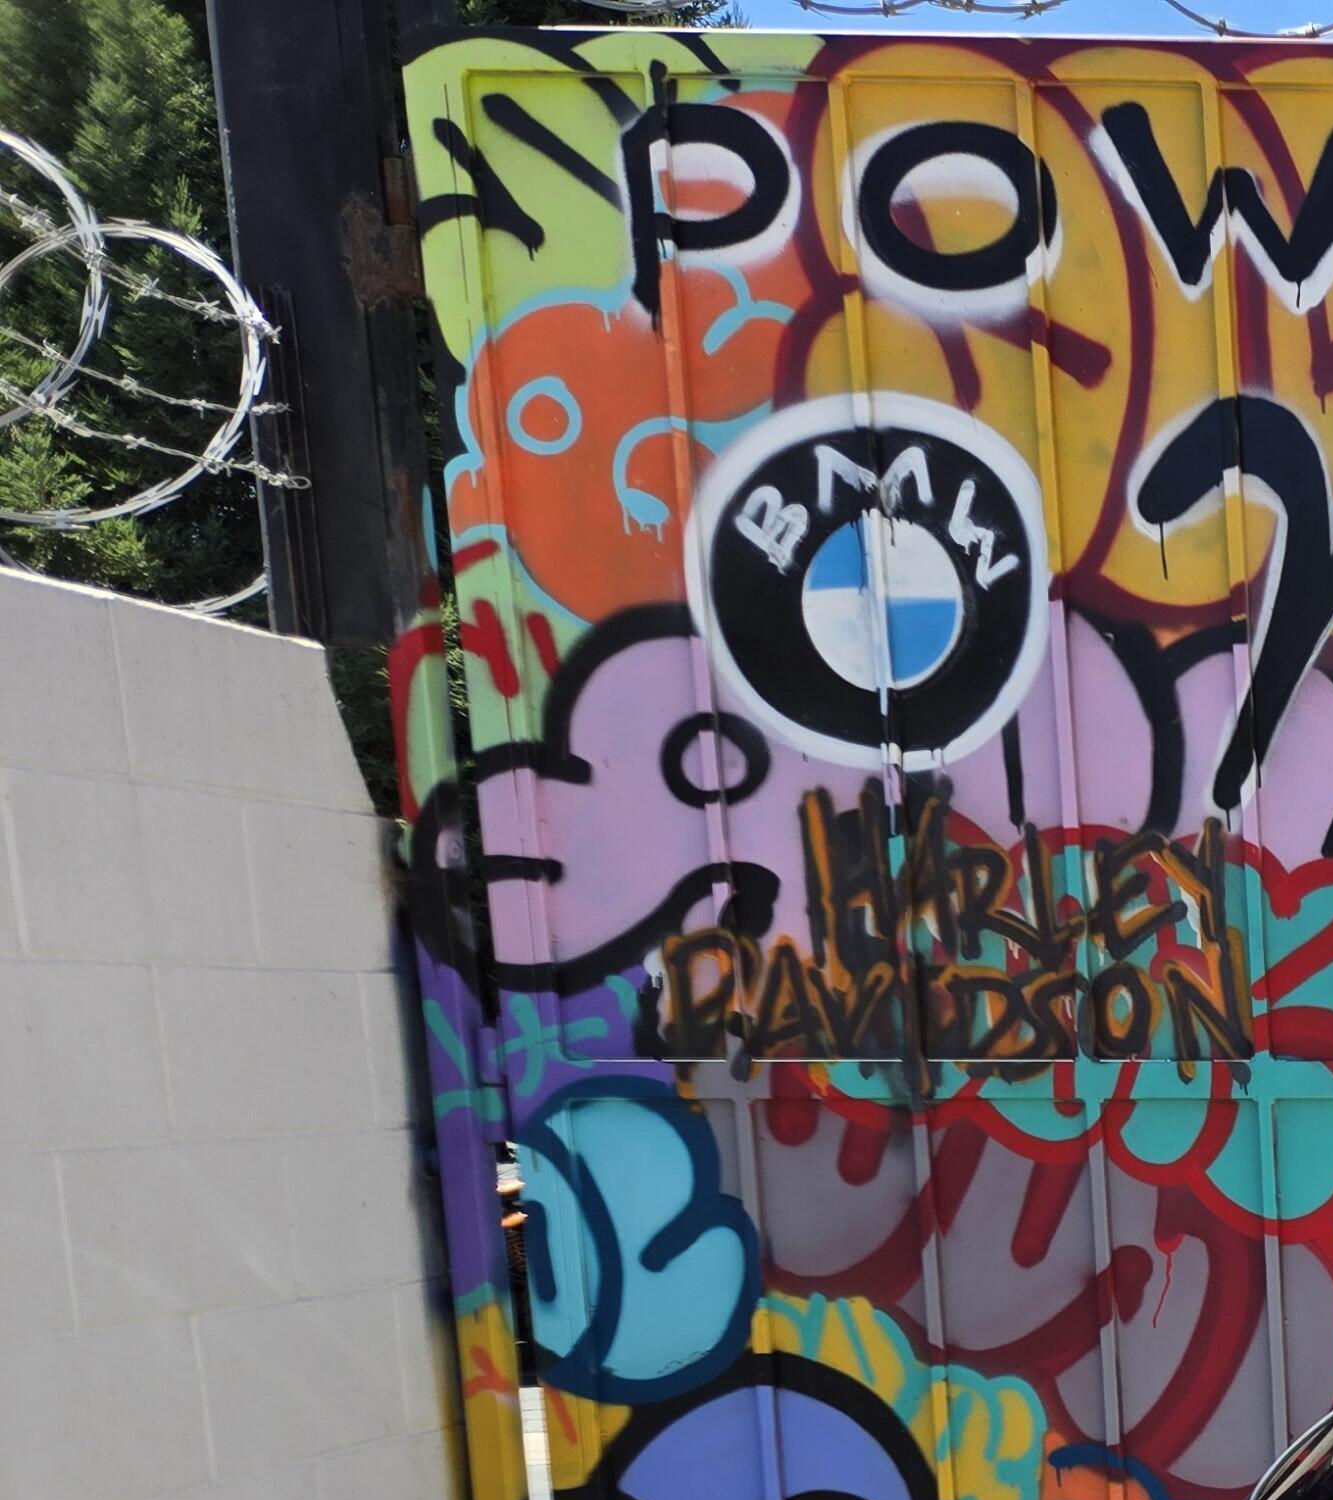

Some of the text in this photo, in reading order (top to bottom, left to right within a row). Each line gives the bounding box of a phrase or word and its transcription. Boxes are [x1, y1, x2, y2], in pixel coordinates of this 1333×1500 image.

[734, 444, 1018, 590] BMW
[798, 778, 1240, 972] HARLEY
[660, 928, 1254, 1092] DAVIDSON
